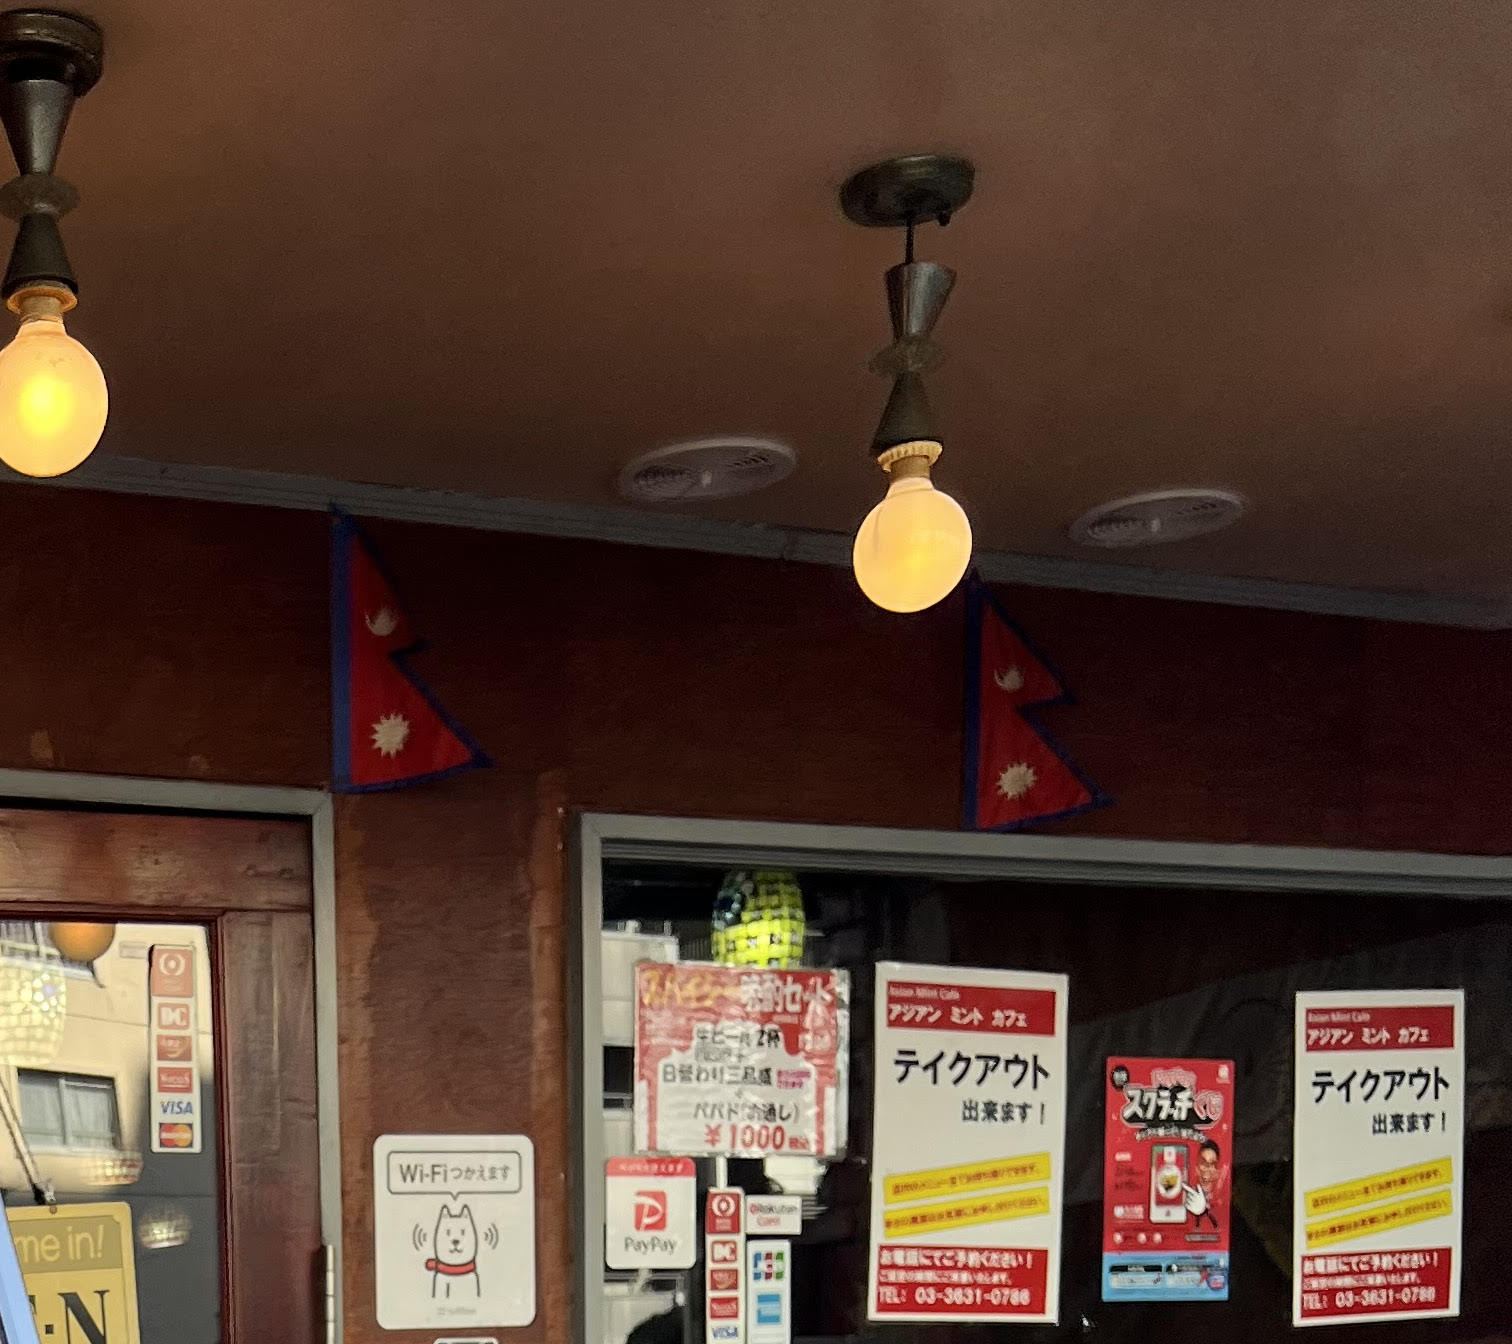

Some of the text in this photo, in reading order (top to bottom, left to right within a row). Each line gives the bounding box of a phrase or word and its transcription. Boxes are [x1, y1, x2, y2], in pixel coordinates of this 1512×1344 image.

[951, 1007, 984, 1025] ミント
[992, 1010, 1027, 1027] カフェ
[1361, 1028, 1390, 1044] ミント
[1398, 1027, 1429, 1044] カフェ
[894, 1050, 1049, 1090] テイクアウト
[1312, 1067, 1449, 1103] テイクアウト
[161, 1101, 193, 1115] VISA
[400, 1164, 447, 1183] Wi-Fi
[67, 1226, 104, 1259] in!
[625, 1236, 677, 1255] PayPay
[712, 1327, 738, 1339] VISA
